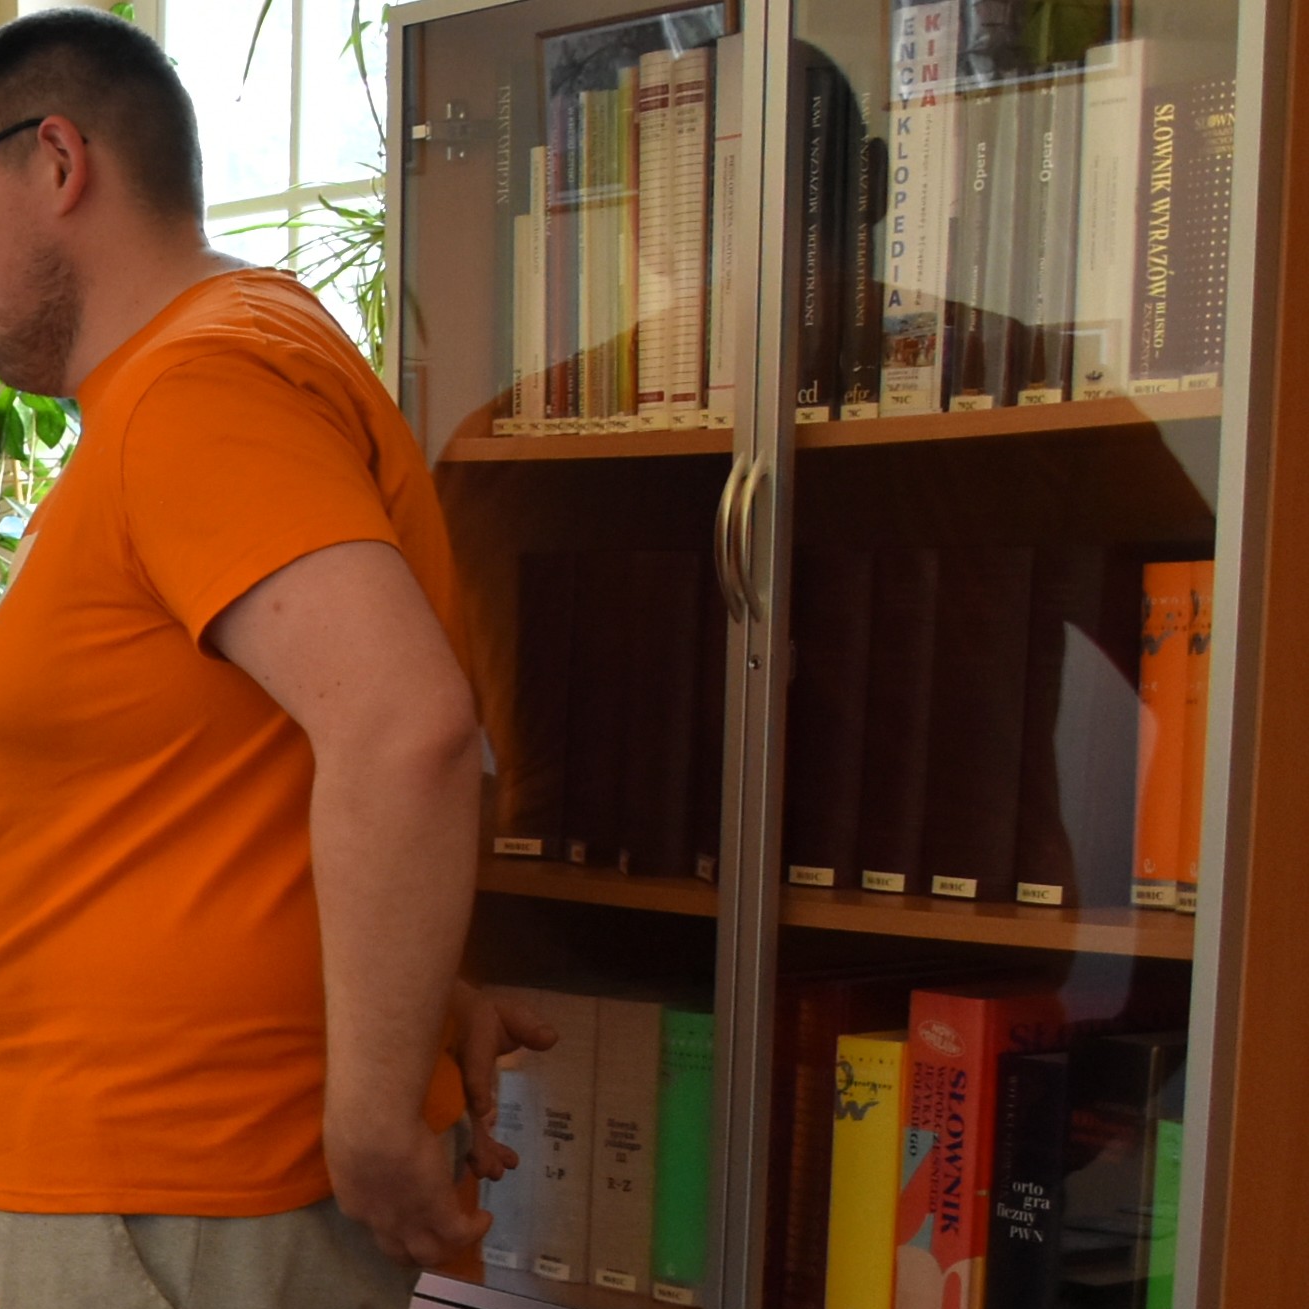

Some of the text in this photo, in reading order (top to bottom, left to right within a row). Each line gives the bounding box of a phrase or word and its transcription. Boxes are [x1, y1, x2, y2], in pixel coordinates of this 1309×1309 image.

[921, 13, 942, 108] KINA
[973, 142, 987, 192] Opera
[1040, 131, 1054, 182] Opera
[803, 95, 822, 327] ENCYKLOPEDIA MUZYCZNA PWM
[1147, 103, 1175, 299] SŁOWNIK WYRAZÓW
[854, 223, 868, 328] ENCYKLOPEDIA
[797, 380, 819, 404] cd
[941, 1069, 967, 1235] SŁOWNIK
[546, 1165, 566, 1180] L-P
[607, 1177, 632, 1193] R-Z
[1012, 1181, 1044, 1197] orto
[996, 1202, 1037, 1226] ficzny
[1023, 1194, 1051, 1211] gra
[1009, 1225, 1044, 1244] PWN
